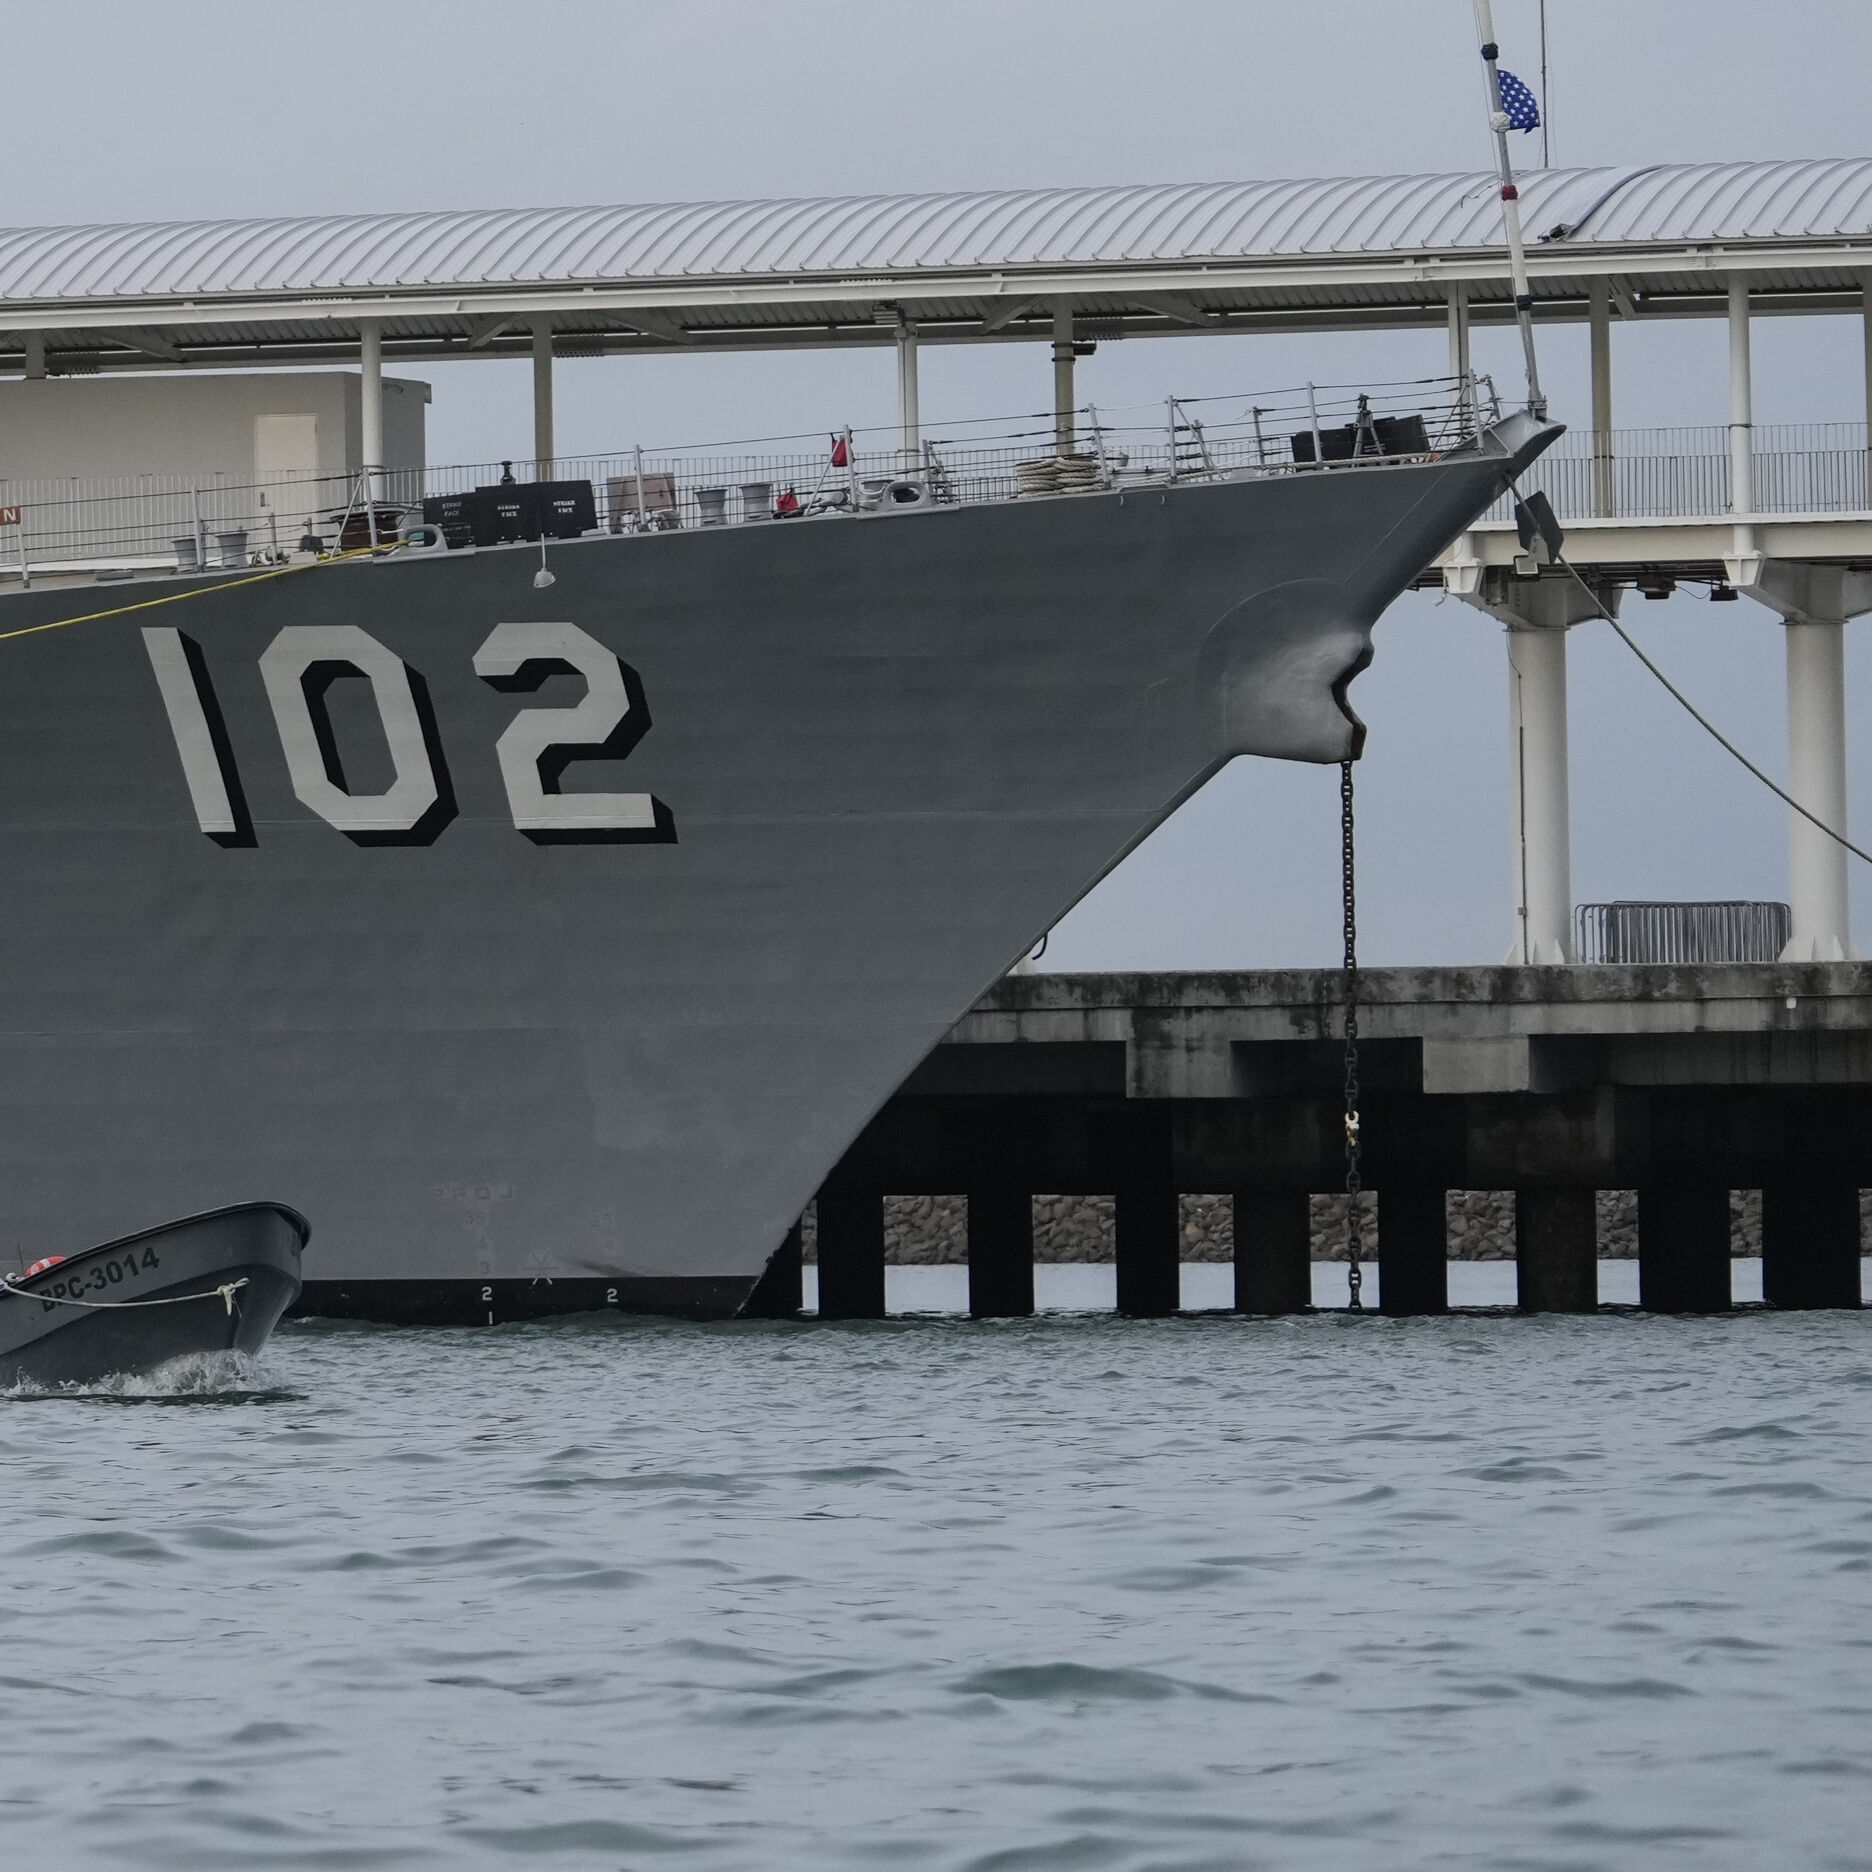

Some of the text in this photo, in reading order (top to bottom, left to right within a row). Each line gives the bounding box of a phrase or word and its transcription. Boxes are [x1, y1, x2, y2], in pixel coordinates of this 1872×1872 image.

[141, 622, 678, 848] 102
[39, 1245, 160, 1313] BPC-3014
[481, 1286, 493, 1301] 2
[606, 1288, 619, 1303] 2
